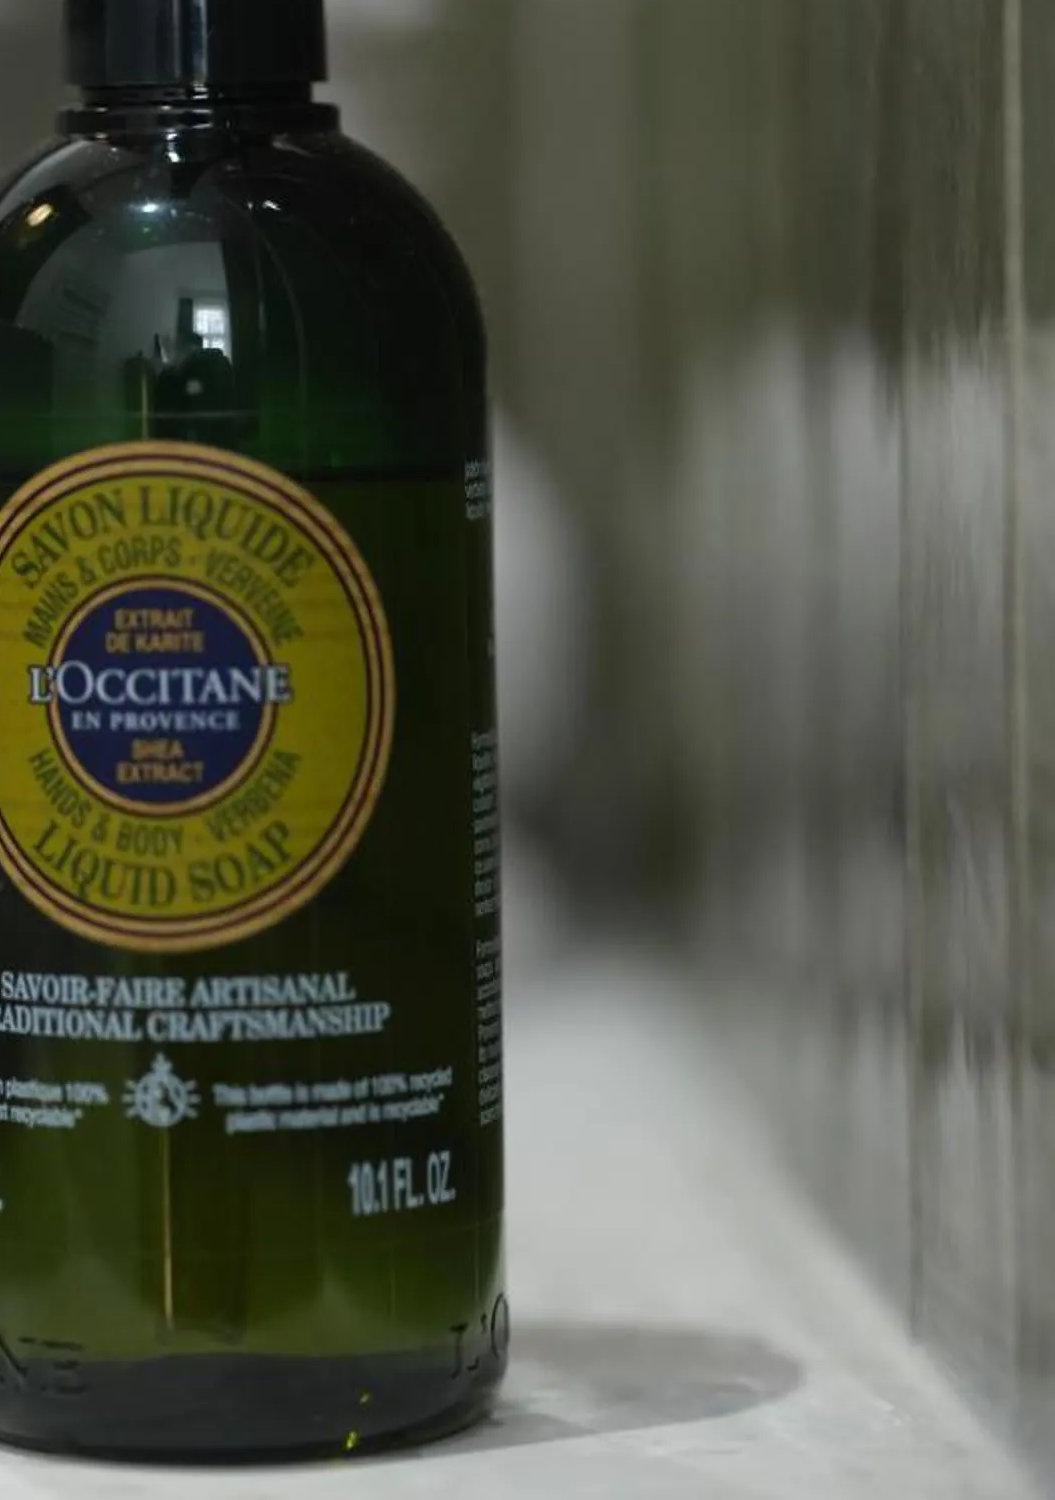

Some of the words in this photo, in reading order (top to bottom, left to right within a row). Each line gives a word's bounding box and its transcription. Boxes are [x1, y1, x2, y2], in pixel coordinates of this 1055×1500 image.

[11, 487, 127, 589] SAVON
[139, 484, 316, 588] LIQUIDE
[22, 571, 78, 649] MAINS
[75, 555, 97, 586] &
[97, 535, 182, 575] CORPS
[205, 547, 304, 647] VERVEINE
[114, 607, 194, 630] EXTRAIT
[105, 631, 130, 653] DE
[71, 710, 101, 731] EN
[110, 710, 241, 731] PROVENCE
[132, 739, 185, 760] SHEA
[116, 761, 204, 784] EXTRACT
[29, 748, 92, 829] HANDS
[90, 812, 110, 845] &
[116, 821, 184, 858] BODY
[204, 749, 302, 841] VERBENA
[33, 817, 178, 910] LIQUID
[186, 819, 291, 903] SOAP
[0, 970, 186, 1007] SAVOIR-FAIRE
[190, 971, 357, 1007] ARTISANAL
[147, 1001, 392, 1042] CRAFTSMANSHIP
[347, 1158, 388, 1216] 10.1
[392, 1156, 425, 1212] FL.
